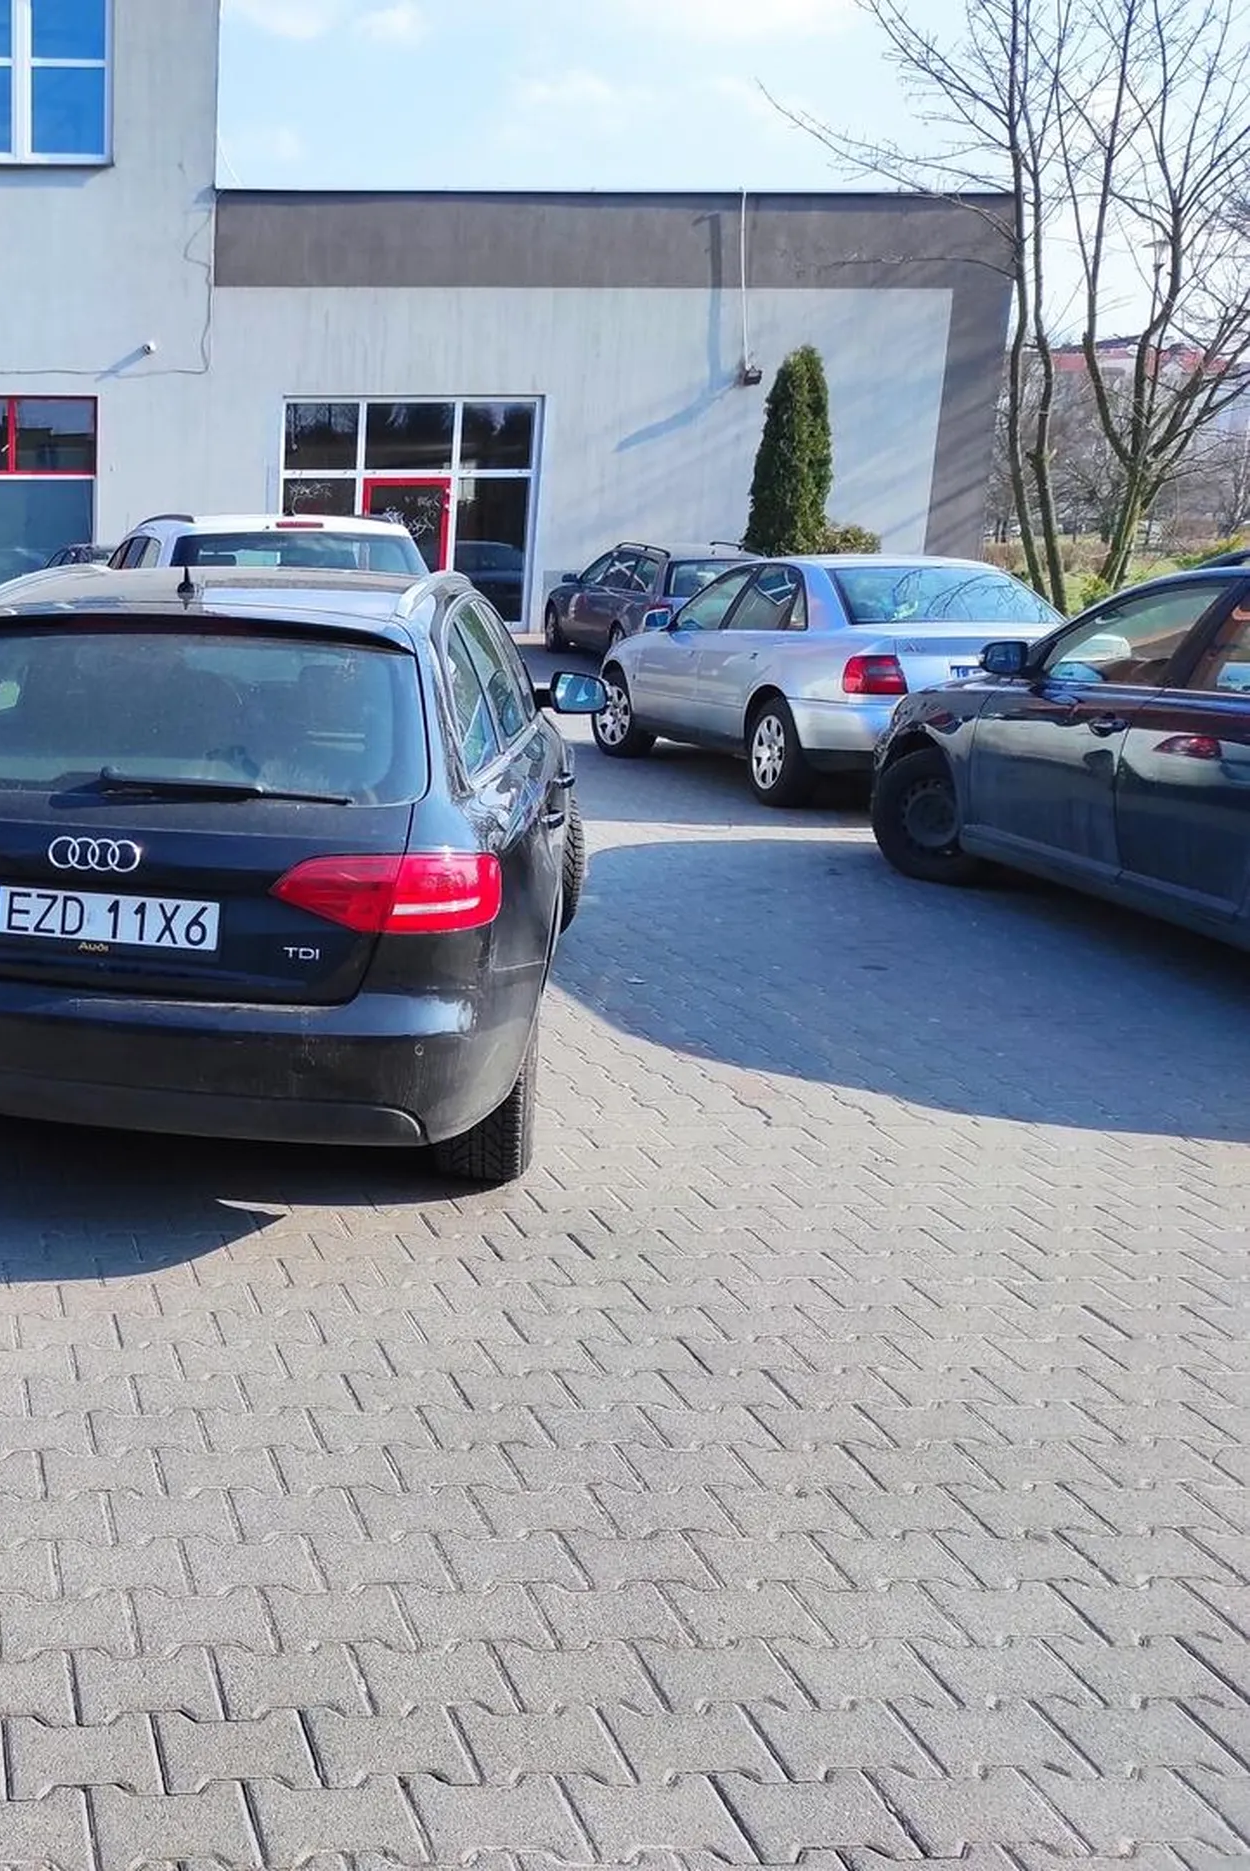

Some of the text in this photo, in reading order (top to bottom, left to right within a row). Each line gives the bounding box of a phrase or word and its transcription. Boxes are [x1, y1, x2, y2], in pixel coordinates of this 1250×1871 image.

[6, 890, 209, 946] EZD 11X6
[77, 940, 110, 952] Audi
[282, 945, 320, 960] TDI
